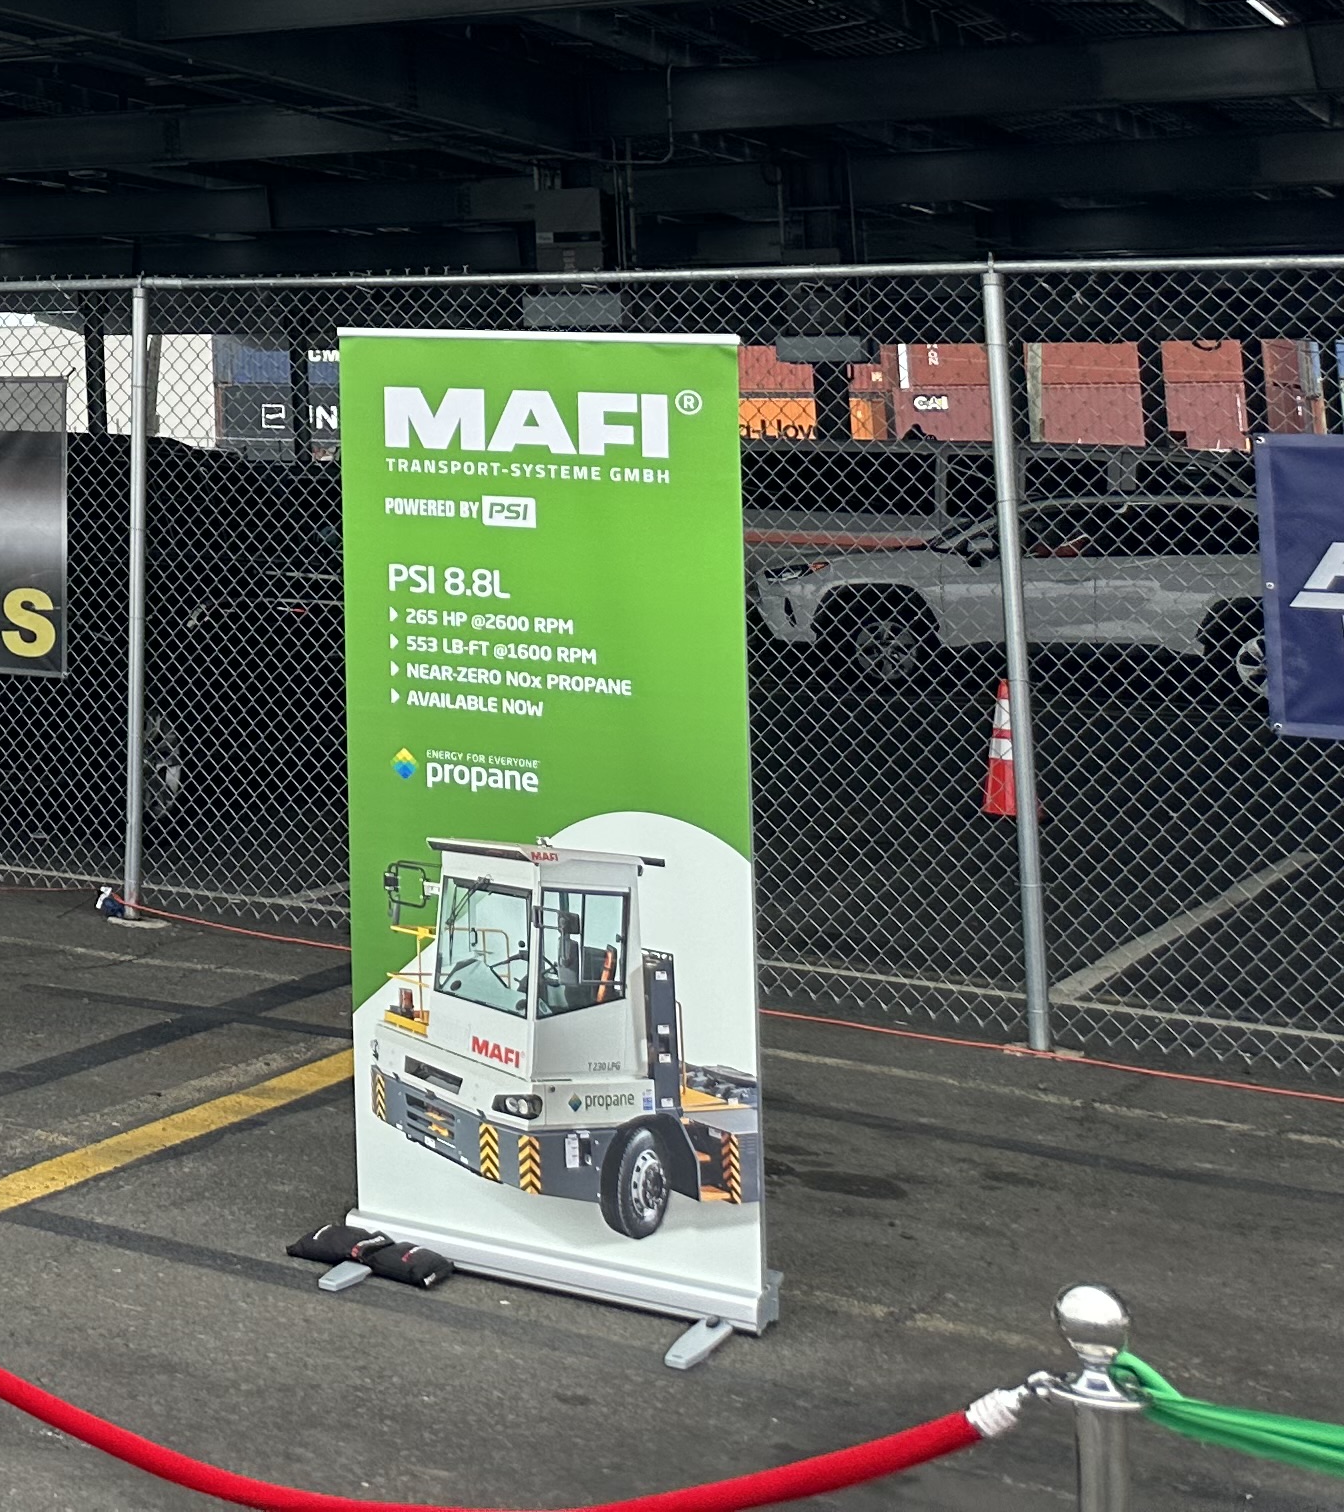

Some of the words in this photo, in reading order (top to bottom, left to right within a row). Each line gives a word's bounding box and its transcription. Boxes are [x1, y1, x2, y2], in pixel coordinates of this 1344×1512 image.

[913, 395, 949, 410] CAI
[385, 458, 601, 481] TRANSPORT-SYSTEME
[610, 467, 670, 484] GMBH
[385, 497, 455, 518] POWERED
[459, 501, 480, 519] BY
[488, 502, 528, 521] PSI
[388, 563, 435, 594] PSI
[443, 566, 511, 599] 8.8L
[406, 608, 438, 625] 265
[442, 610, 468, 627] HP
[471, 614, 530, 632] @2600
[534, 617, 574, 635] RPM
[407, 636, 438, 652] 553
[442, 638, 490, 656] LB-FT
[493, 644, 552, 662] @1600
[557, 647, 597, 665] RPM
[407, 663, 502, 685] NEAR-ZERO
[506, 671, 542, 689] NOx
[547, 674, 632, 696] PROPANE
[407, 690, 498, 713] AVAILABLE
[502, 698, 544, 717] NOW
[426, 749, 463, 761] ENERGY
[466, 752, 486, 764] FOR
[426, 762, 539, 792] propane
[593, 1061, 607, 1072] 230
[607, 1060, 621, 1071] LPG
[584, 1093, 635, 1111] propane
